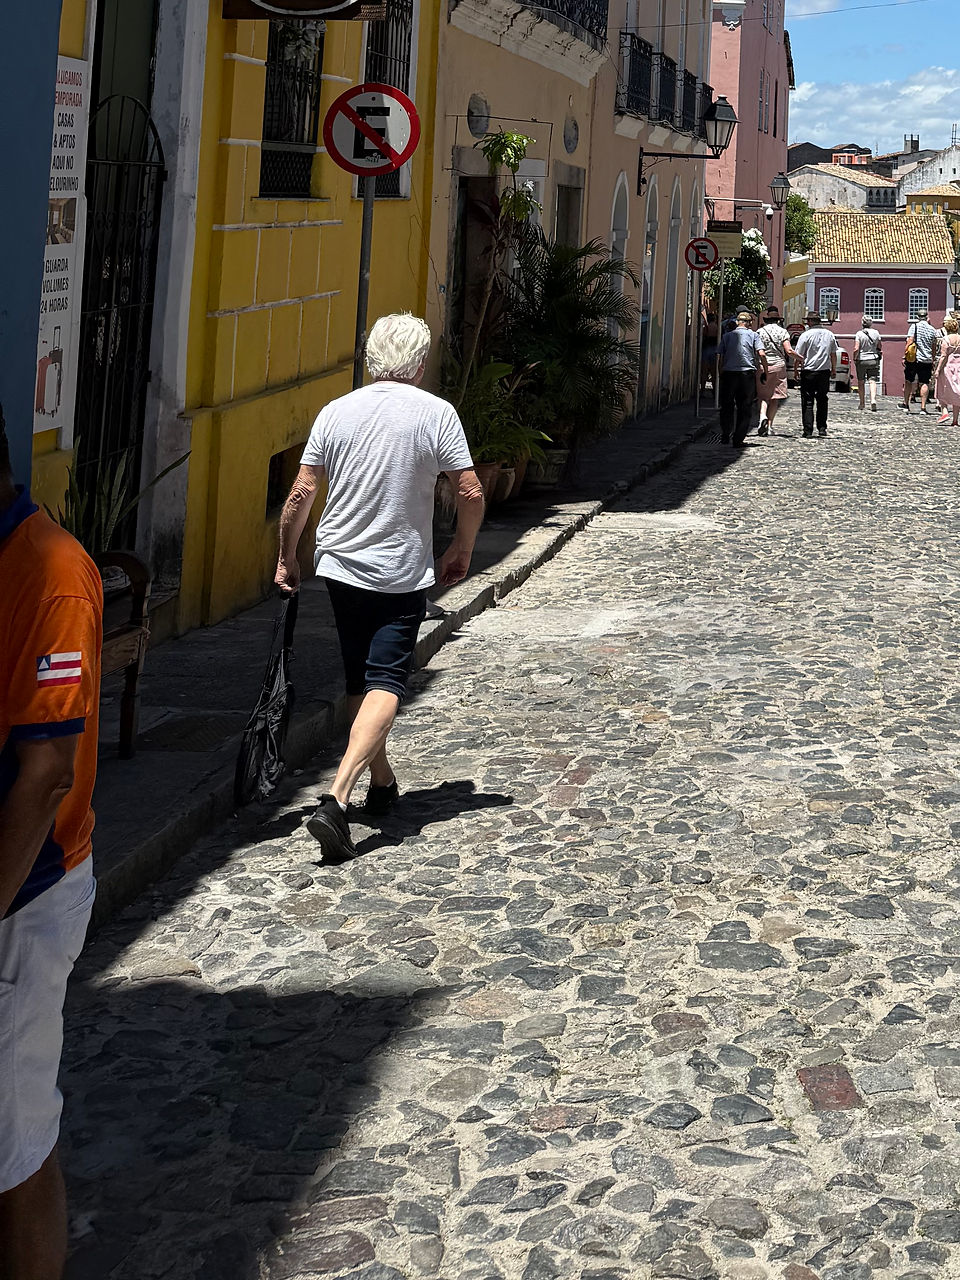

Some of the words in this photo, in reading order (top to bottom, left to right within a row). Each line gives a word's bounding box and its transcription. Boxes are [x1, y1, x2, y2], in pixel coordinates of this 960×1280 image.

[56, 69, 83, 87] LUGAMOS
[55, 90, 83, 108] EMPORADA
[57, 112, 75, 128] CASAS
[59, 134, 76, 149] APTOS
[51, 155, 65, 170] AQUI
[65, 155, 74, 170] NO
[49, 176, 79, 191] ELOURINHO
[45, 258, 69, 274] GUARDA
[42, 277, 69, 294] VOLUMES
[40, 299, 48, 314] 24
[48, 296, 69, 313] HORAS
